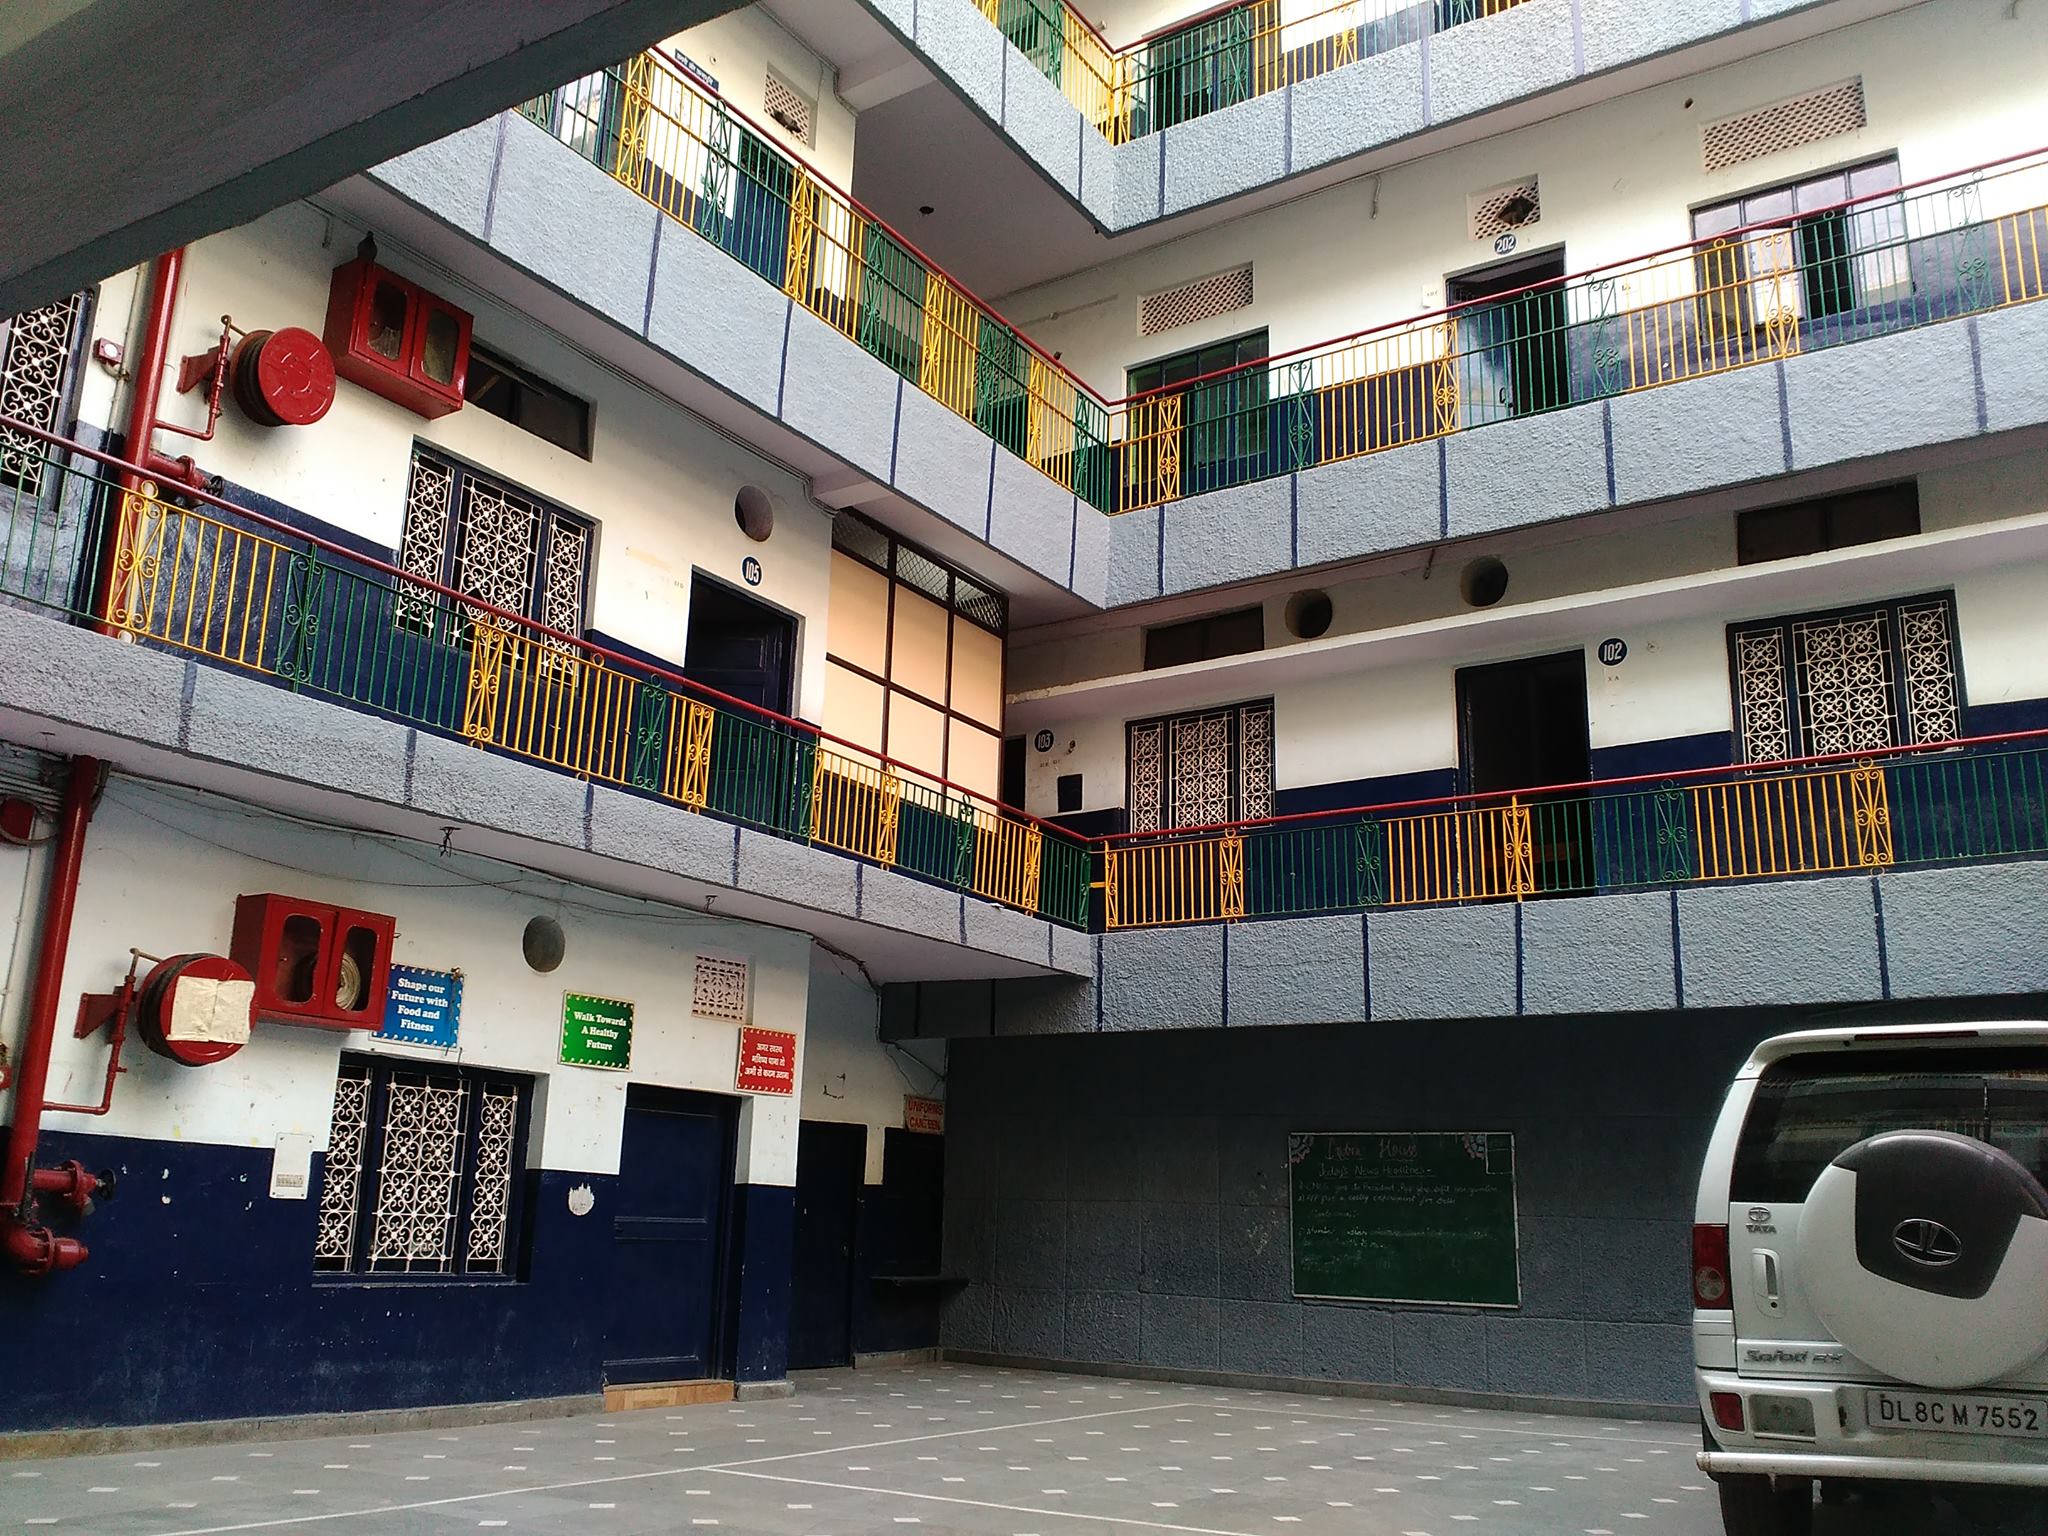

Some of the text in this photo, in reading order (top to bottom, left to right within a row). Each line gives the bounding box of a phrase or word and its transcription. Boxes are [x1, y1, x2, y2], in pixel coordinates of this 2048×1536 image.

[1495, 235, 1515, 253] 202
[745, 560, 760, 584] 105
[1603, 641, 1623, 662] 102
[1037, 733, 1052, 749] 103
[398, 977, 446, 993] Shape our
[391, 990, 449, 1007] Future with
[397, 1004, 440, 1019] Food and
[573, 1011, 627, 1026] Walk Towards
[400, 1018, 434, 1032] Fitness
[581, 1025, 619, 1040] A Healthy
[586, 1039, 613, 1051] Future
[910, 1116, 941, 1131] CANTEEN
[1745, 1222, 1777, 1234] TATA
[1976, 1404, 2039, 1431] 7552
